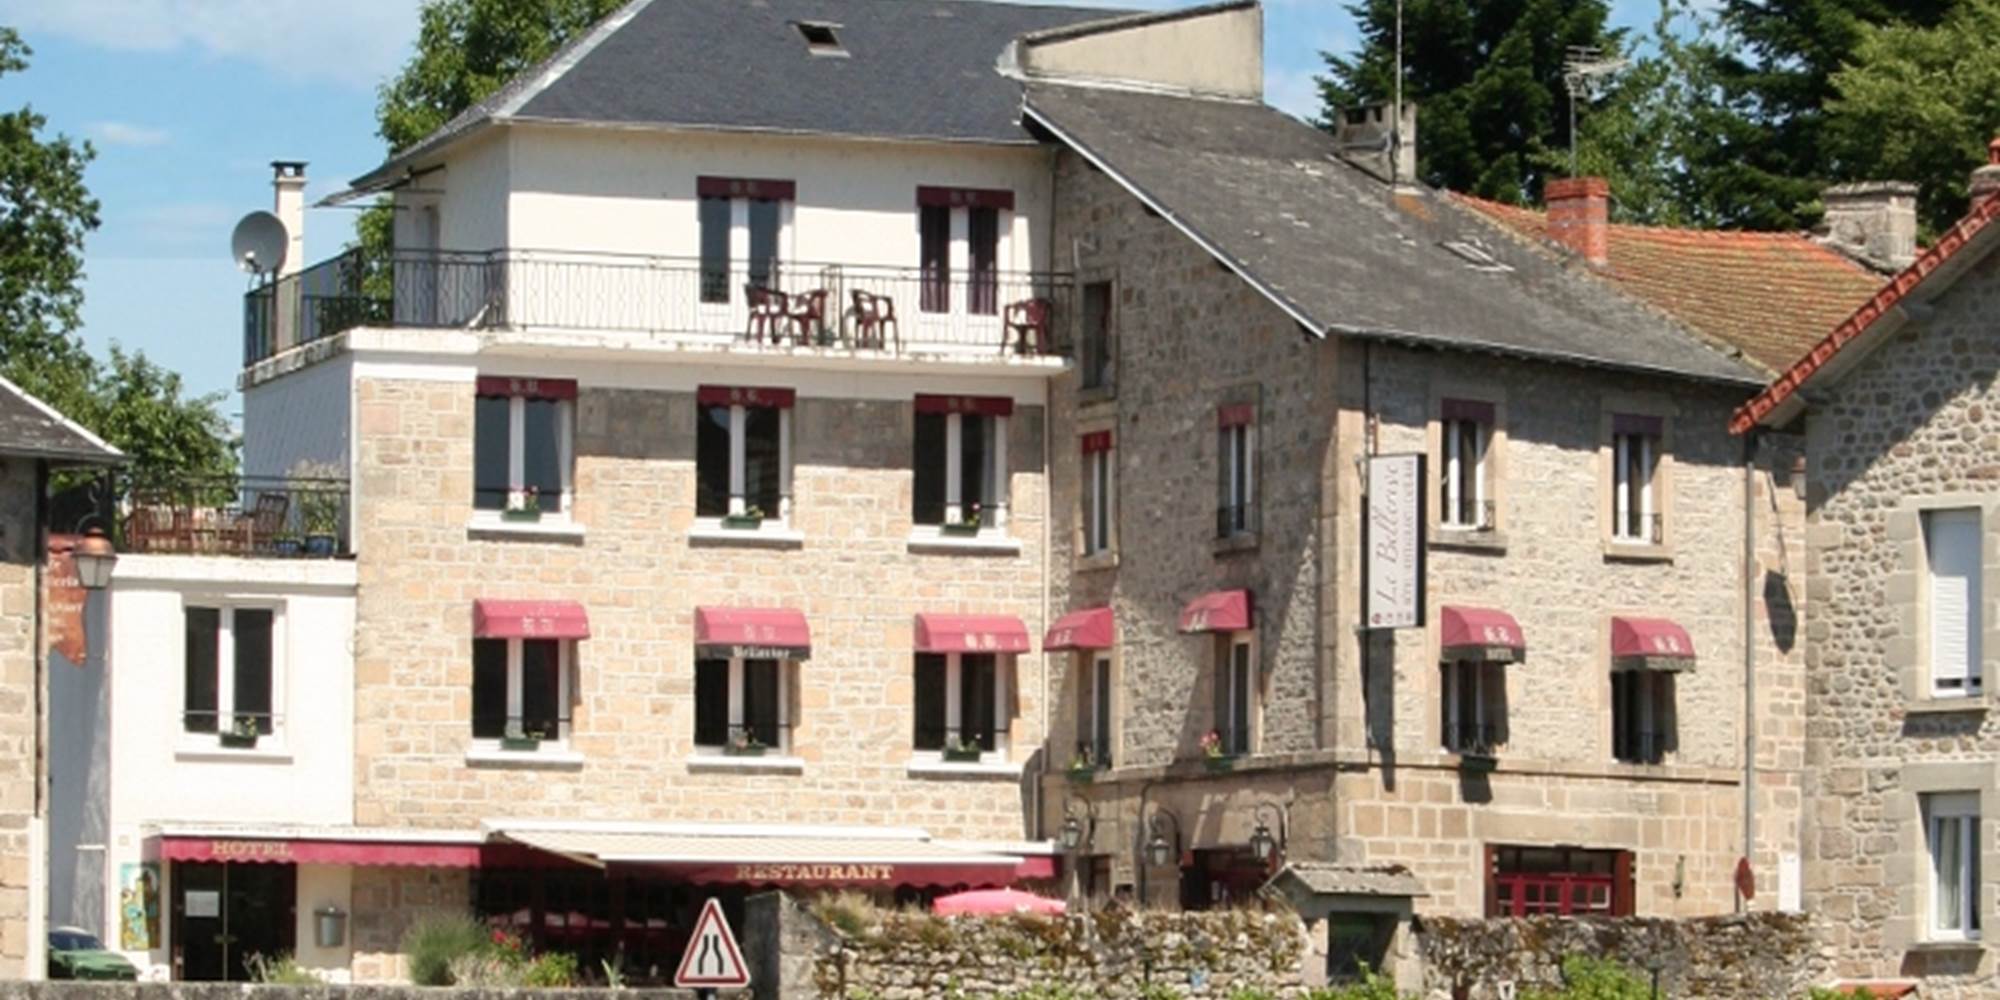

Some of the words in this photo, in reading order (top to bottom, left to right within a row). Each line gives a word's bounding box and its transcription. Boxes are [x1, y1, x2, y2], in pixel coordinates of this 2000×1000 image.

[1375, 577, 1397, 606] Le
[211, 841, 292, 856] HOTEL
[736, 864, 894, 880] RESTAURANT
